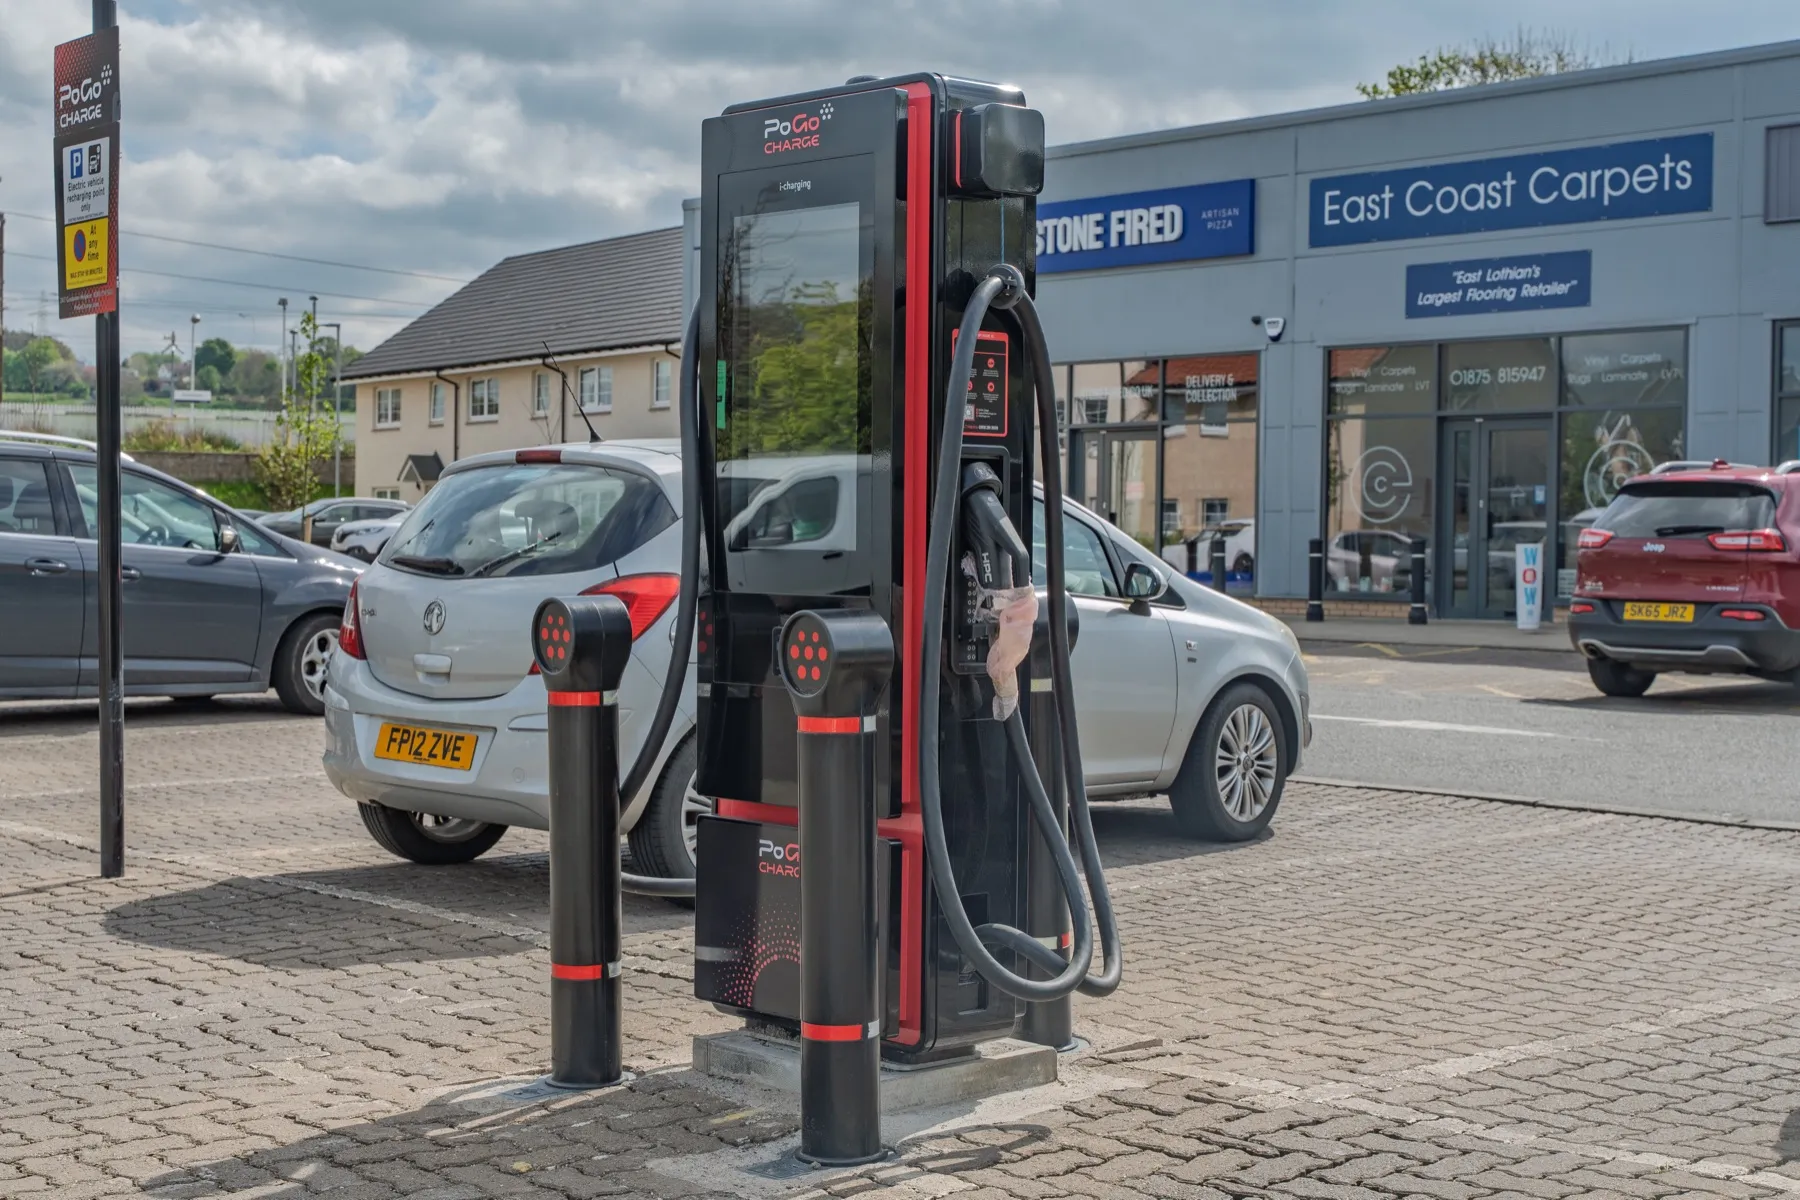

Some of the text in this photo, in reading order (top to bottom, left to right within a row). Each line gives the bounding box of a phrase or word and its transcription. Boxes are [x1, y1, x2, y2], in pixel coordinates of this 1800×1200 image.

[60, 78, 101, 109] PoGo
[60, 103, 102, 128] CHARGE
[764, 113, 820, 138] PoGo
[764, 134, 820, 154] CHARGE
[68, 177, 104, 192] Electric vehicle
[1323, 153, 1692, 225] East Coast Carpets
[66, 187, 105, 203] recharging point
[80, 202, 91, 212] only
[1201, 208, 1239, 219] ARTISAN
[90, 224, 96, 235] At
[1036, 204, 1184, 256] STONE FIRED
[1207, 220, 1233, 230] PIZZA
[89, 240, 98, 249] any
[87, 251, 99, 261] time
[1486, 265, 1541, 282] Lothian's
[1417, 289, 1463, 307] Largest
[1466, 286, 1517, 302] Flooring
[1584, 353, 1661, 368] Vinyl Carpets
[1351, 365, 1416, 379] Vinyl Carpets
[1450, 366, 1546, 386] 01875 815947
[1567, 373, 1591, 385] Rugs
[1602, 371, 1648, 382] Laminate
[1185, 374, 1226, 388] DELIVERY
[1336, 381, 1430, 395] Rugs Laminate LVT
[1185, 388, 1237, 403] COLLECTION
[982, 552, 993, 583] HPC
[1629, 604, 1687, 619] SK65 JRZ
[386, 727, 465, 762] FP12 ZVE
[759, 839, 799, 862] PoG
[759, 861, 799, 878] CHARG
